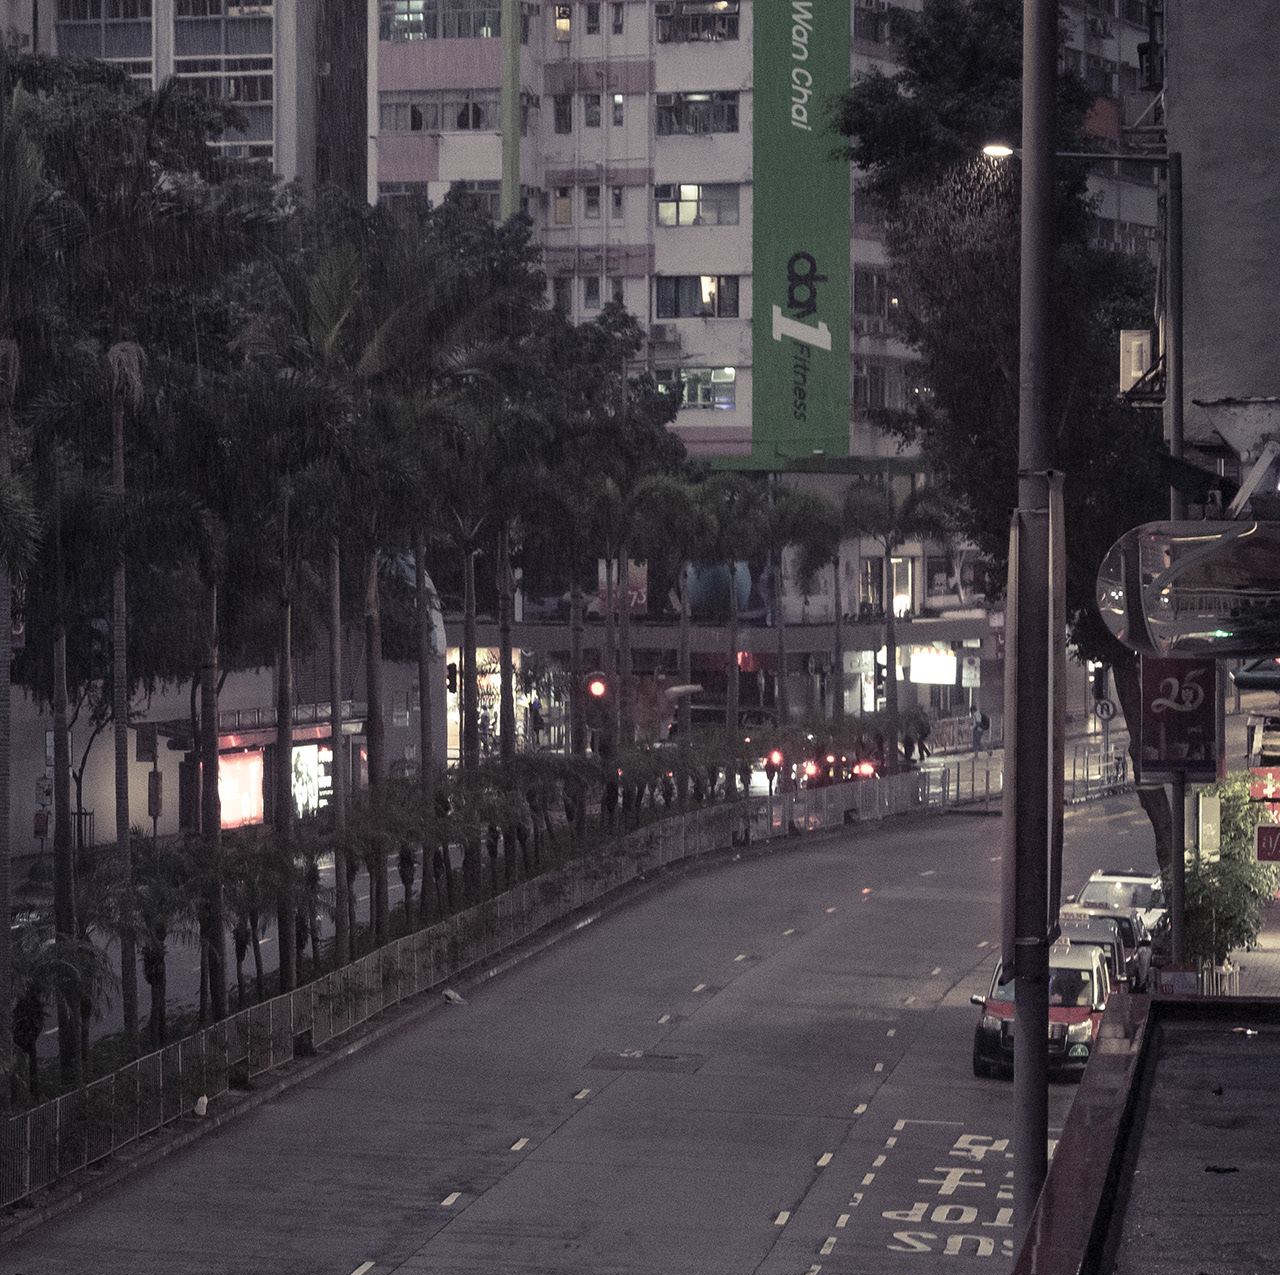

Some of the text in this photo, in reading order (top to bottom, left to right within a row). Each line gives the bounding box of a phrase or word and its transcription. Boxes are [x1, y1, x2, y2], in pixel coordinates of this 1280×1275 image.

[790, 0, 814, 132] Wan Chai
[792, 342, 813, 423] Fitness
[1151, 669, 1205, 713] 25
[882, 1202, 1014, 1227] TOP
